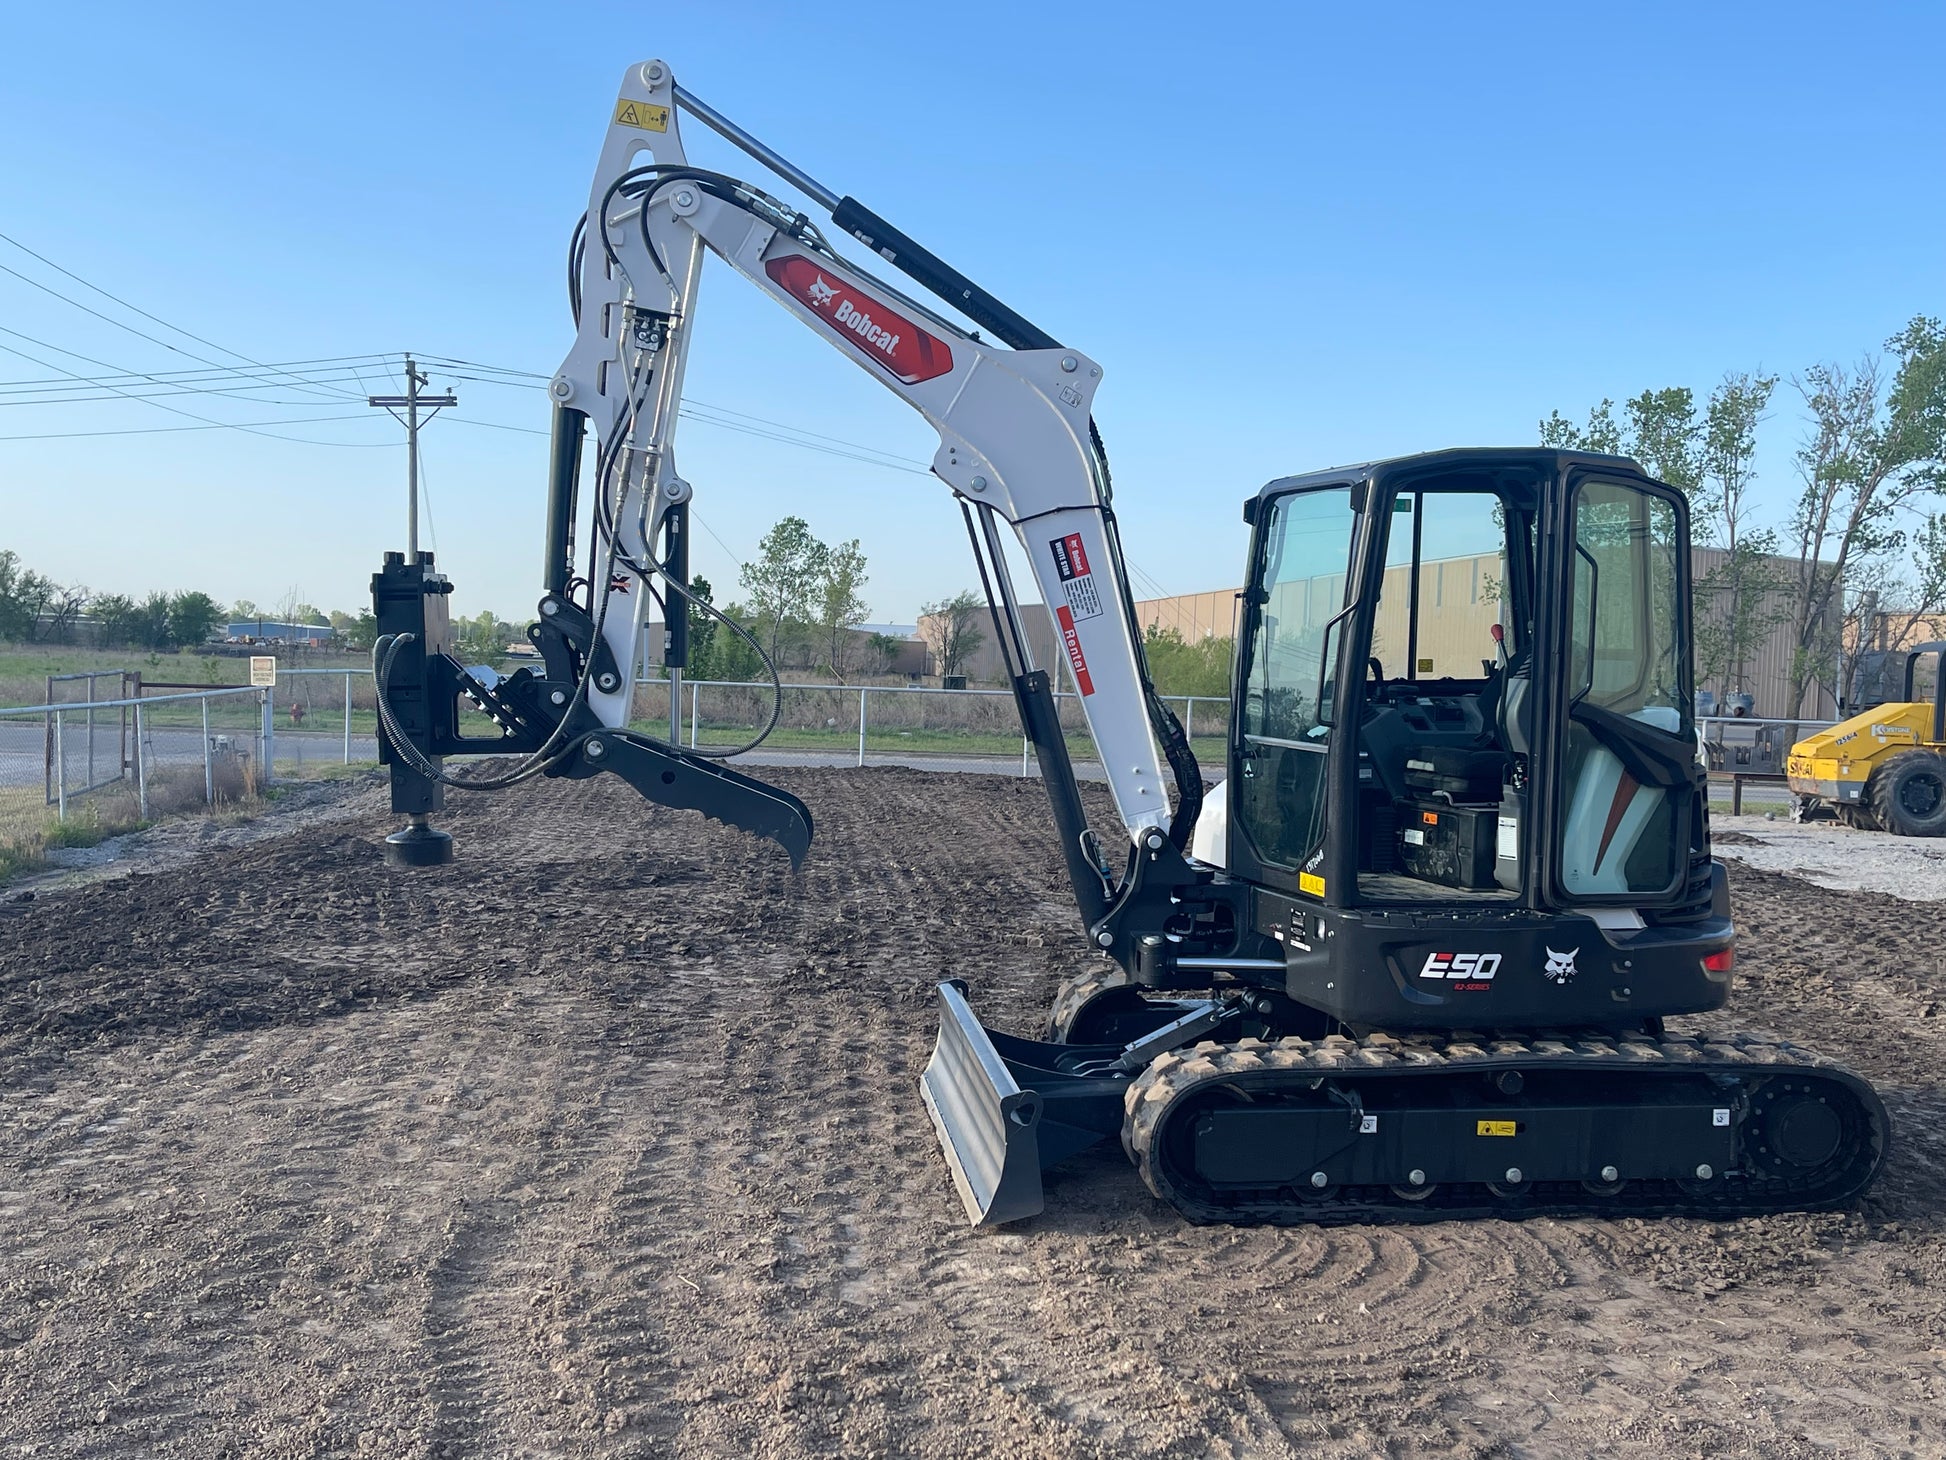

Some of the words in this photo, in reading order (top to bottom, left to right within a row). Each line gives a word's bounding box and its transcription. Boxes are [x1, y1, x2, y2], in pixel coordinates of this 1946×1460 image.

[834, 299, 901, 355] Bobcat
[1055, 541, 1066, 560] WHITE
[1072, 550, 1083, 572] Bobcat
[1060, 560, 1070, 576] STAR
[1064, 629, 1086, 673] Rental
[1419, 952, 1503, 980] E50
